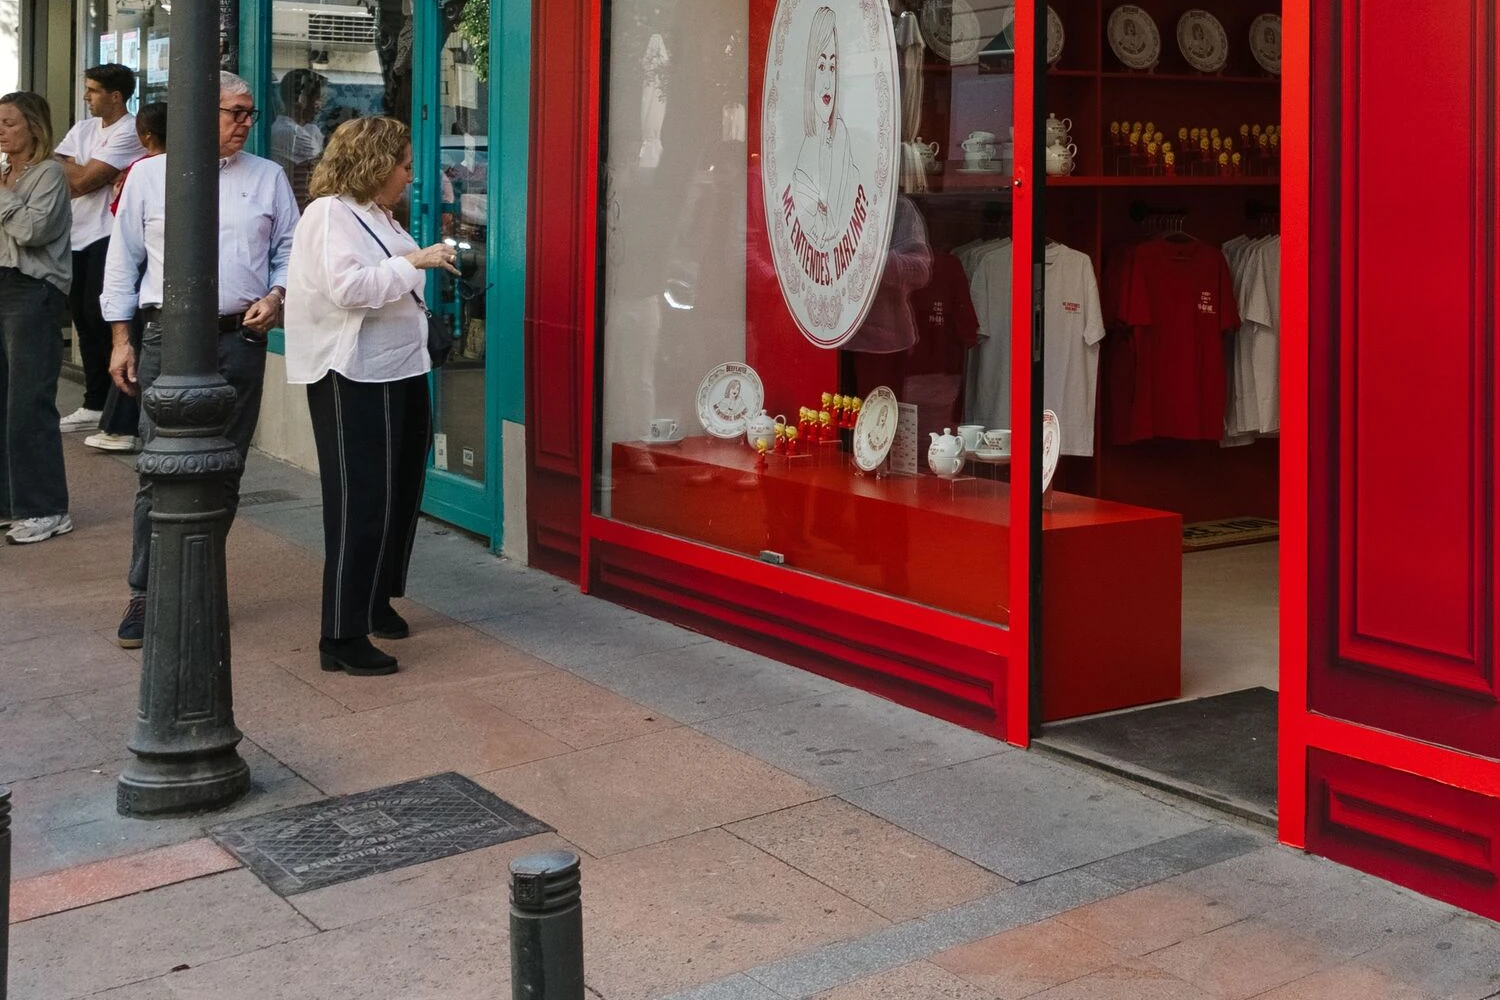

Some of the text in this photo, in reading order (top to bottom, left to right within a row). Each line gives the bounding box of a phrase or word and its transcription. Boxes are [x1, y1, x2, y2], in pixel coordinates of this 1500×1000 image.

[782, 183, 869, 287] ME ENTIENDES, DARLING?
